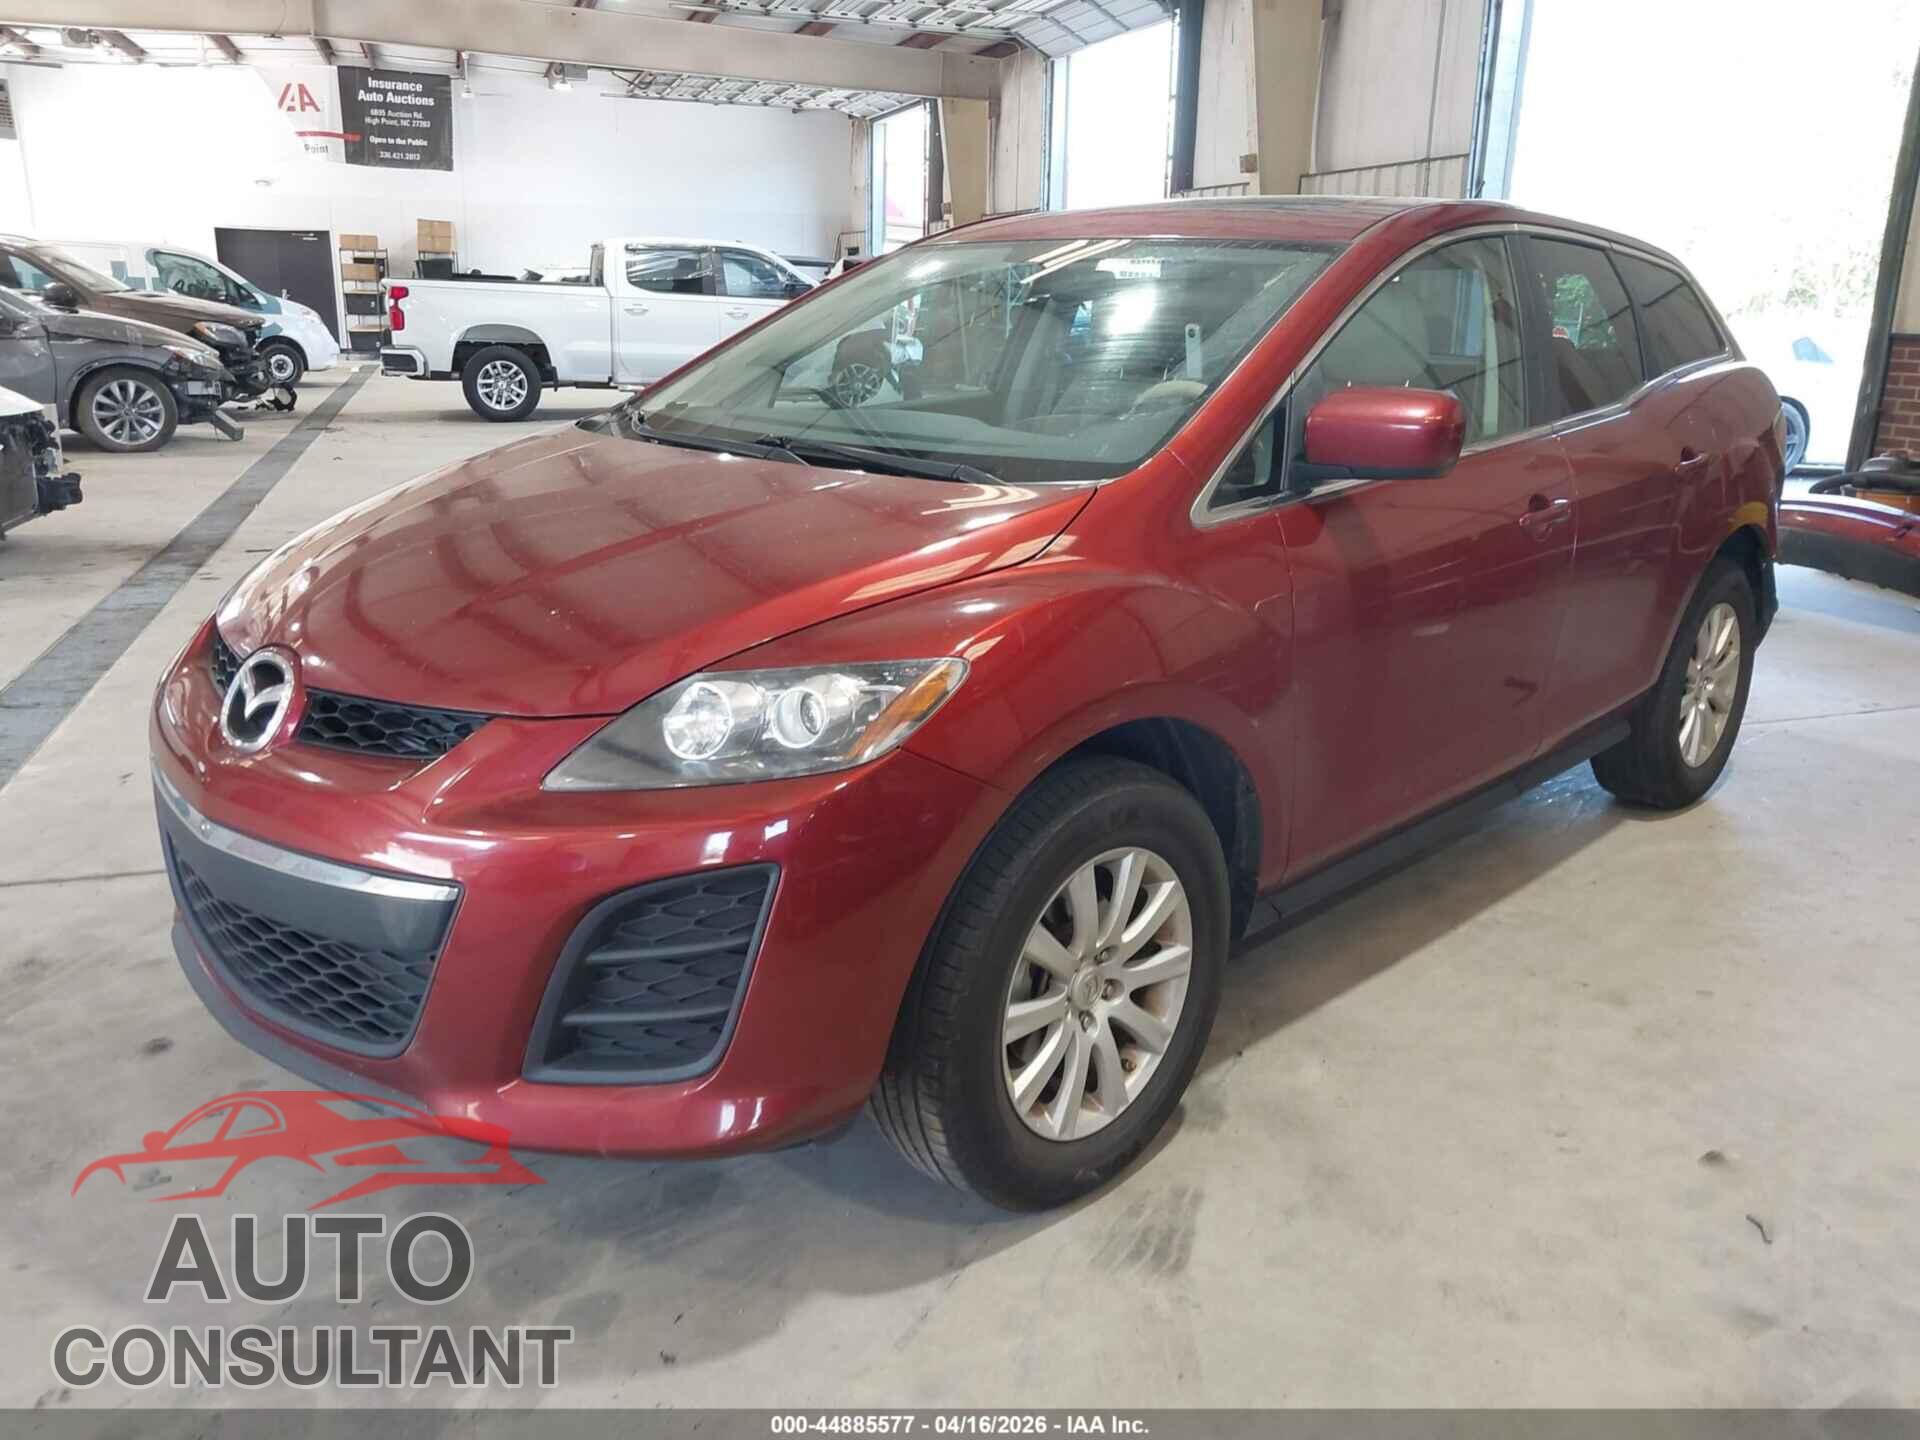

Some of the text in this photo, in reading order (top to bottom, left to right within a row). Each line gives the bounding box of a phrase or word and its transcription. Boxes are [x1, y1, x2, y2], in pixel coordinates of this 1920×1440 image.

[368, 76, 423, 92] Insurance
[358, 89, 435, 106] Auto Auctions
[387, 109, 412, 118] Auction
[364, 116, 380, 126] High
[400, 119, 410, 127] NC
[369, 135, 387, 144] Open
[407, 138, 428, 146] Public
